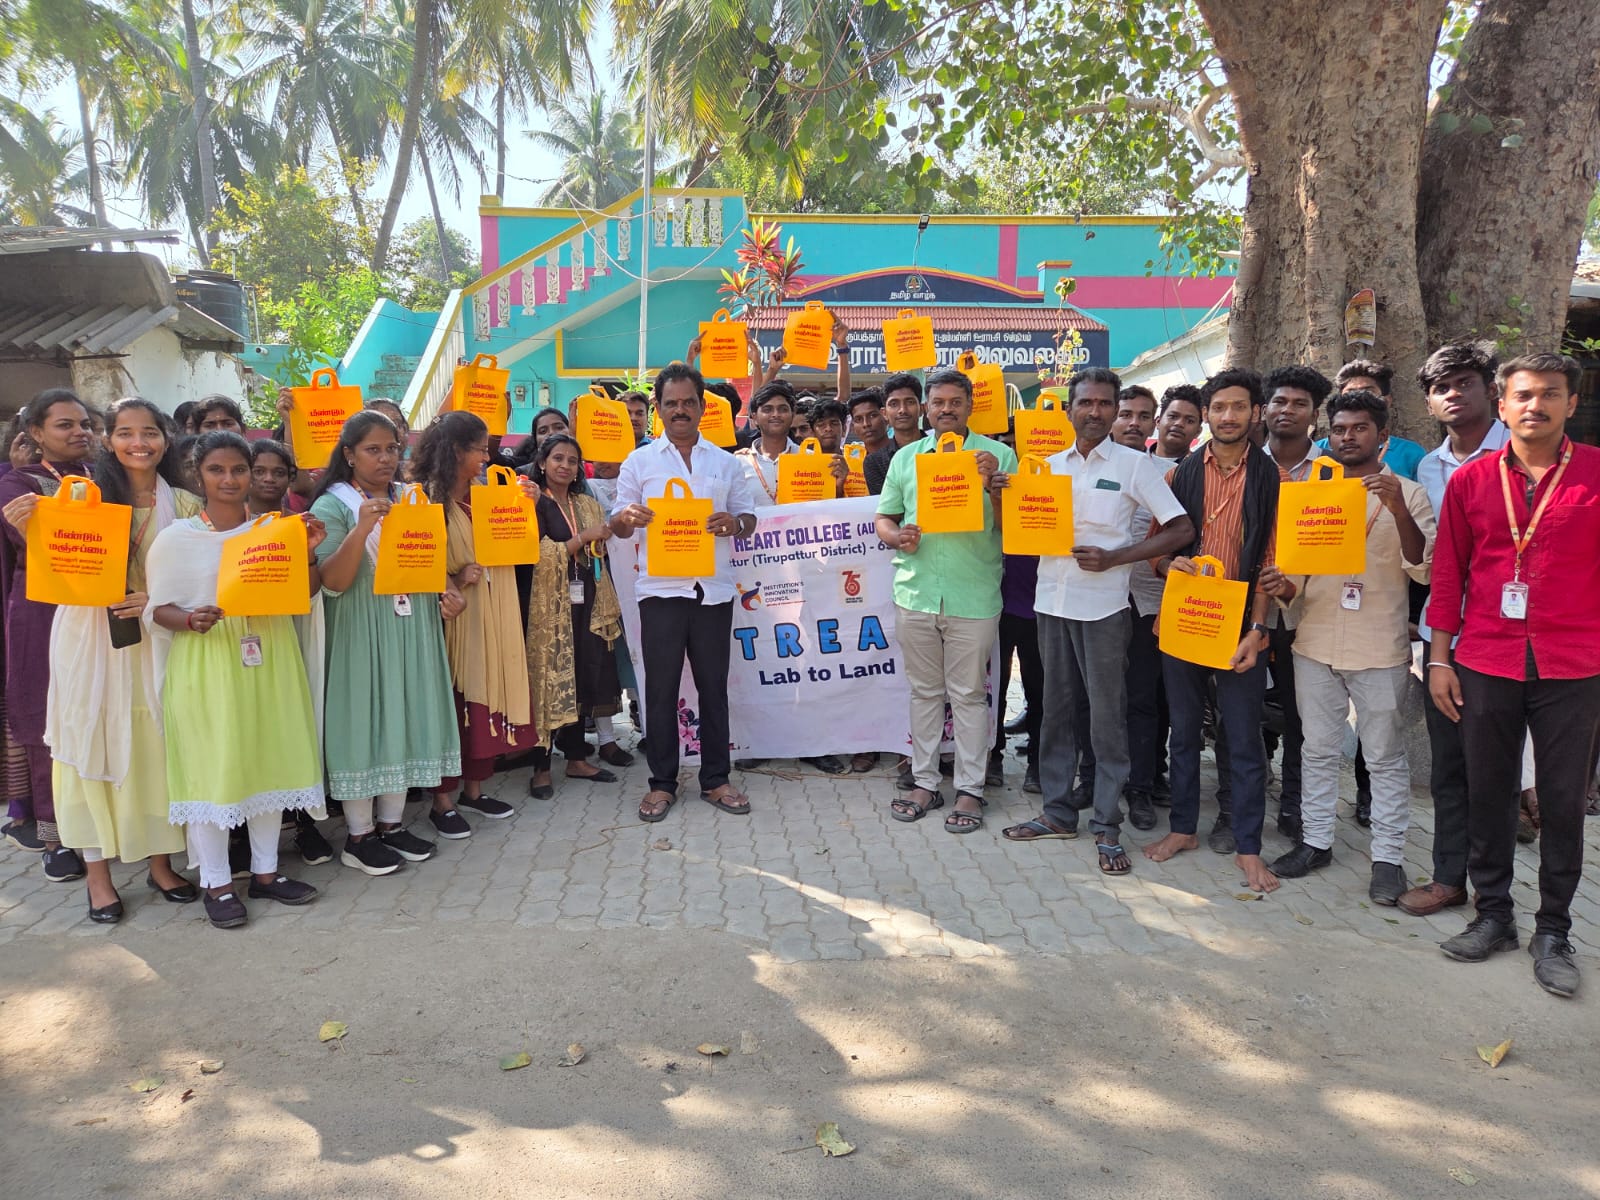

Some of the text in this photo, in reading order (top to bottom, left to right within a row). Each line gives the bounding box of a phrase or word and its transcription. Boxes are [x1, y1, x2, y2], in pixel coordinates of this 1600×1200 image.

[889, 290, 936, 301] தமிழ் வாழ்க
[1302, 505, 1343, 515] மீண்டும்
[1296, 517, 1347, 527] மஞ்சப்பை
[54, 529, 103, 542] மீண்டும்
[734, 522, 876, 552] HEART COLLEGE (AU
[48, 542, 108, 555] மஞ்சப்பை
[243, 541, 286, 555] மீண்டும்
[729, 557, 750, 568] tur
[752, 550, 818, 568] (Tirupattur
[820, 541, 866, 558] District)
[877, 541, 893, 552] 6
[238, 553, 291, 567] மஞ்சப்பை
[763, 581, 805, 592] INSTITUTION'S
[764, 588, 800, 597] INNOVATION
[1184, 595, 1223, 610] மீண்டும்
[1177, 607, 1225, 621] மஞ்சப்பை
[759, 658, 896, 686] Lab to Land
